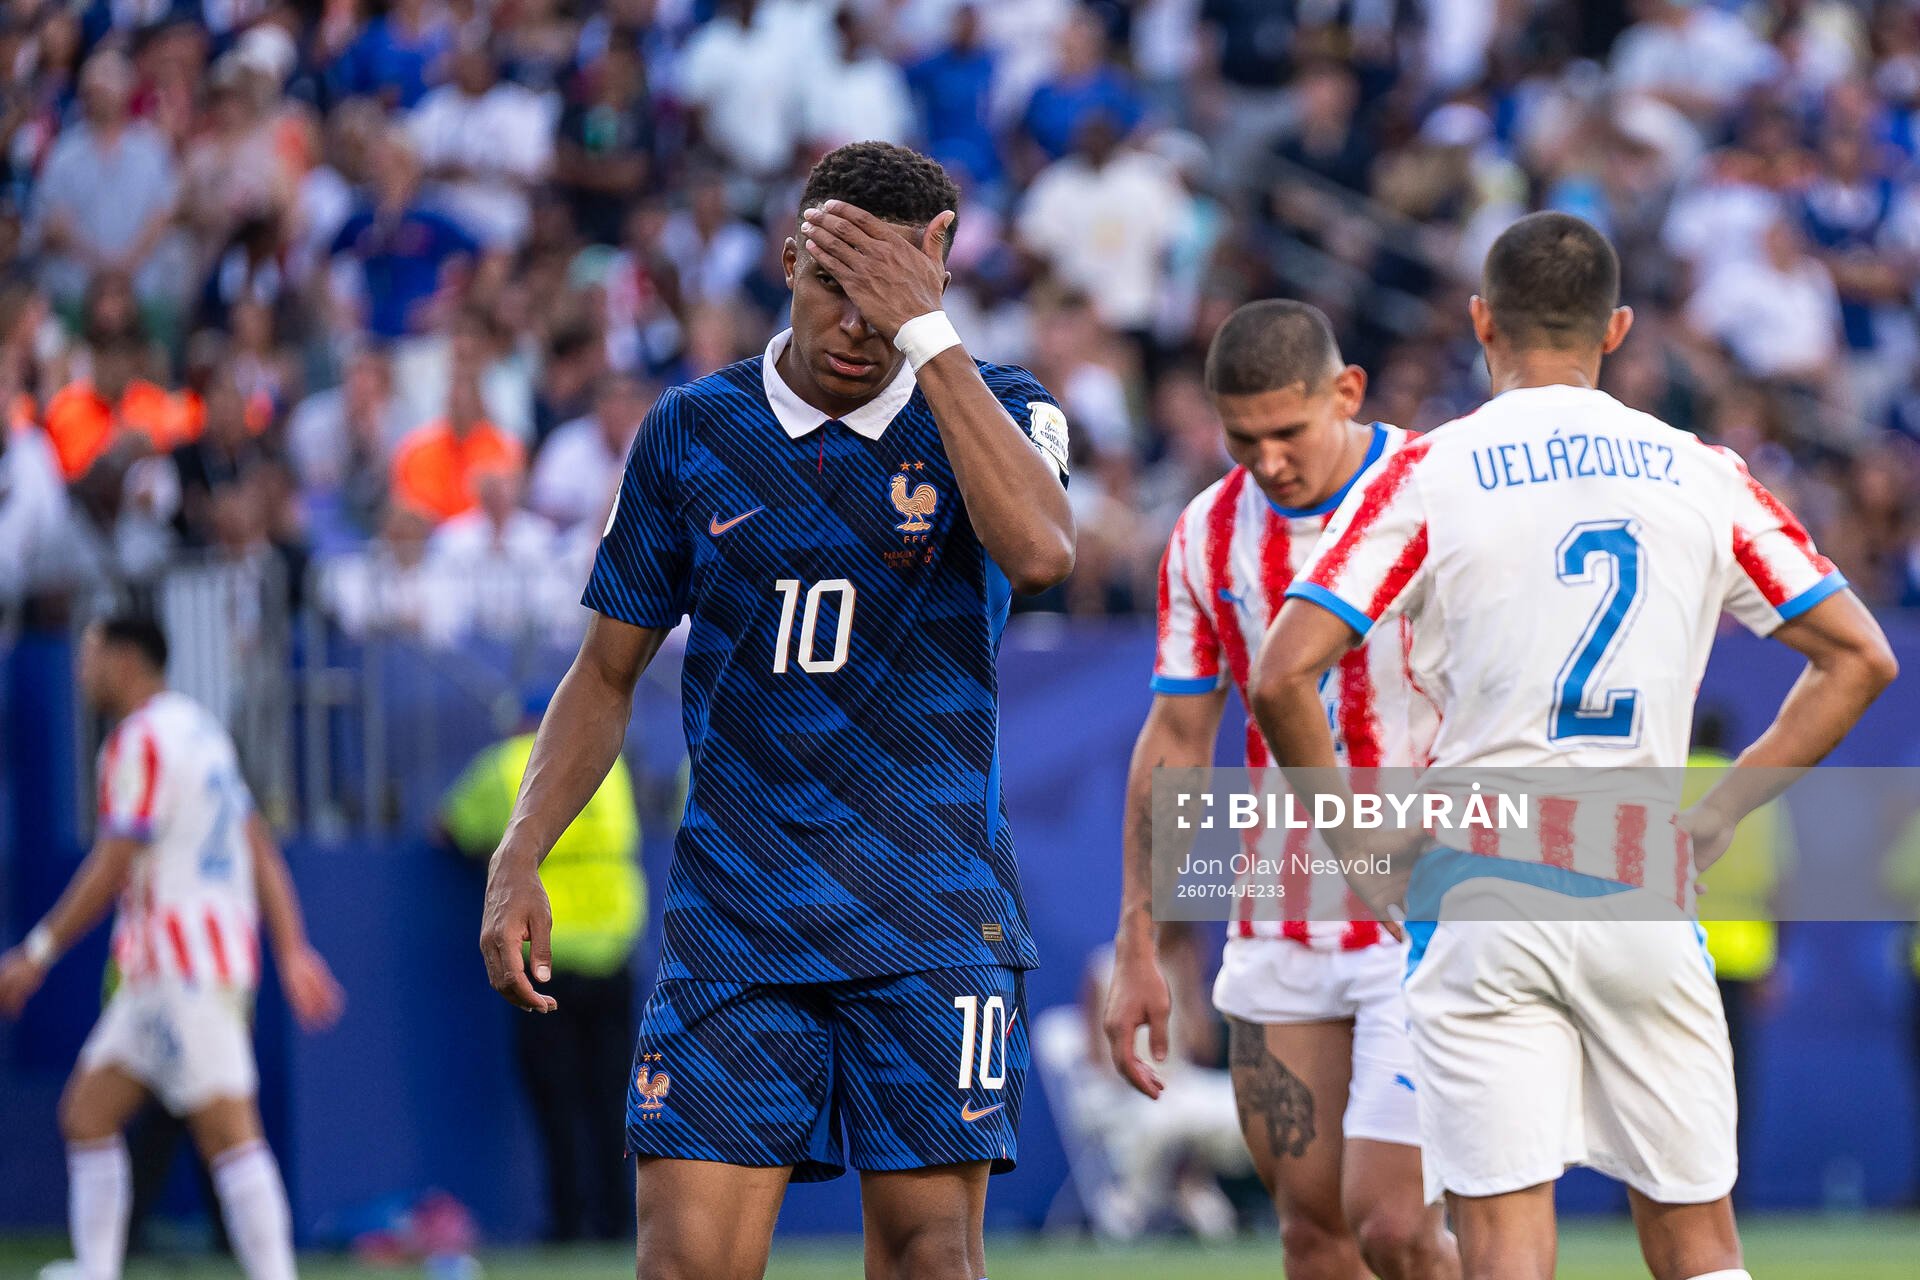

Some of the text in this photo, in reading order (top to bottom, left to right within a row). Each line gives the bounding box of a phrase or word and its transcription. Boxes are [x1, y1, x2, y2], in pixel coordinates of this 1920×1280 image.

[1472, 429, 1680, 490] VELÁZQUEZ
[773, 579, 857, 673] 10
[1547, 519, 1648, 748] 2
[954, 995, 1006, 1090] 10
